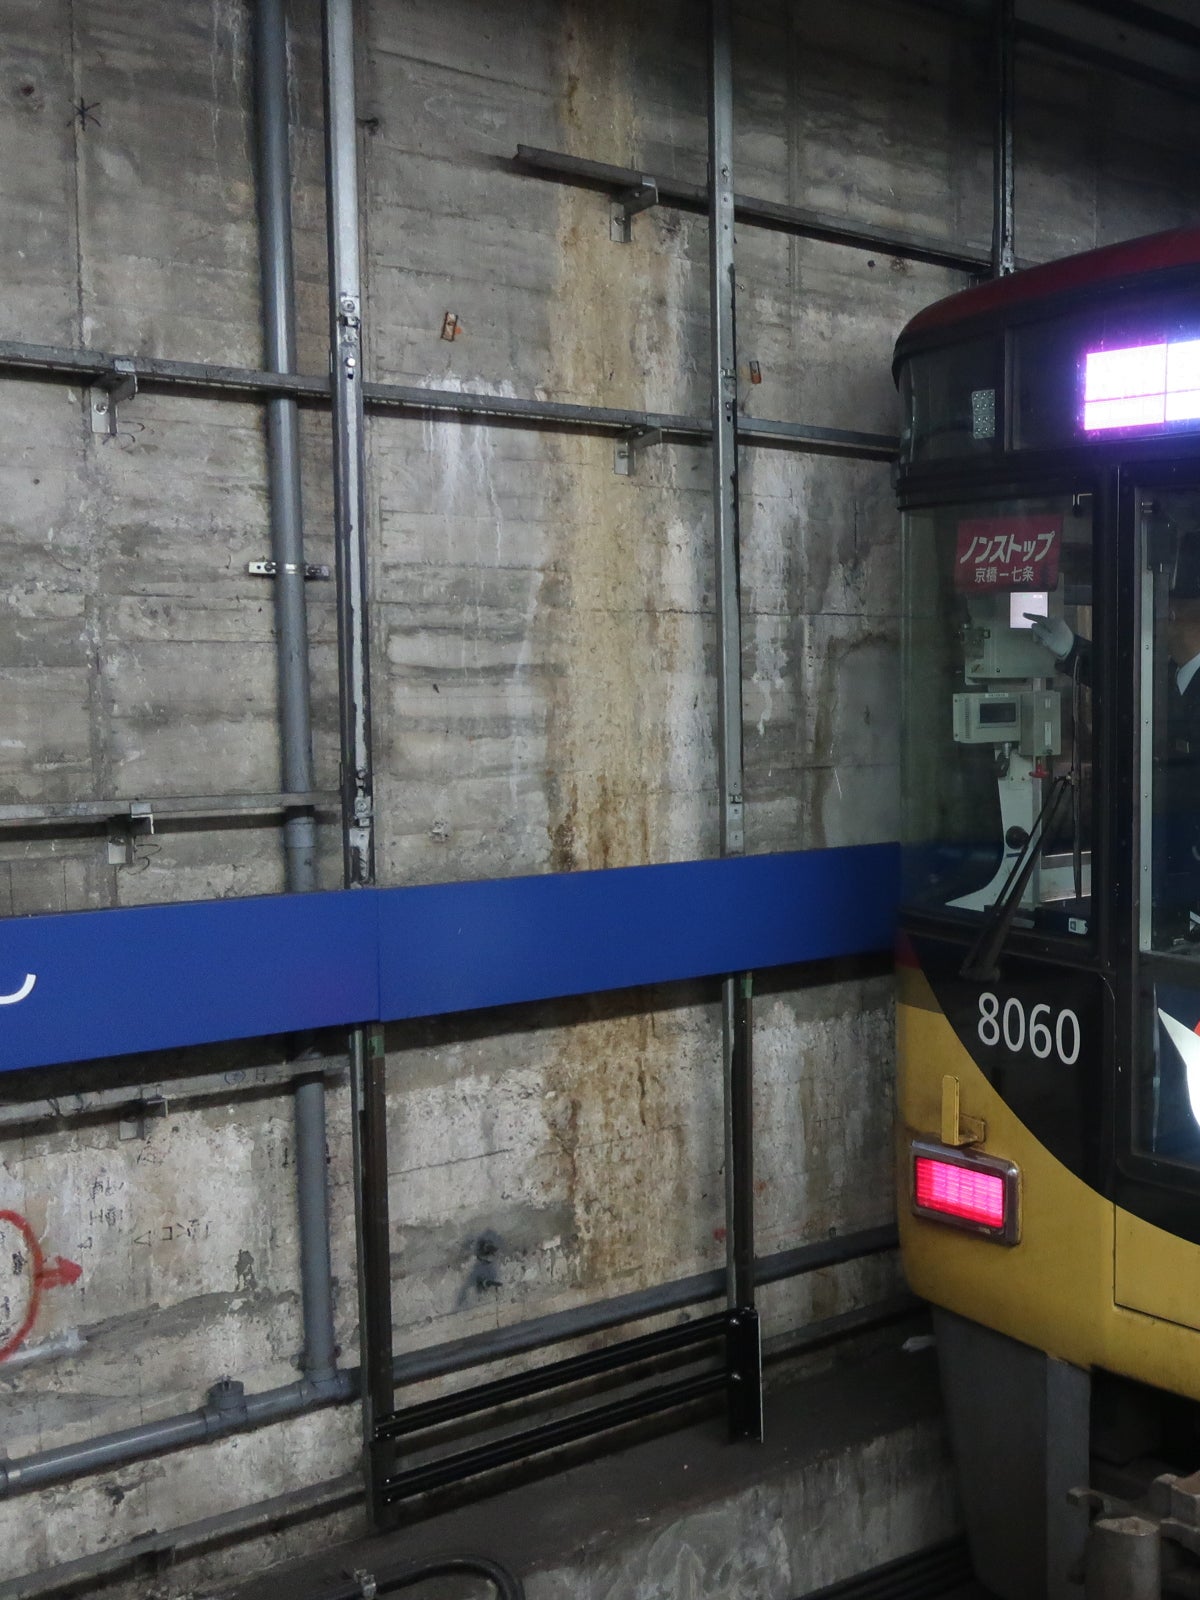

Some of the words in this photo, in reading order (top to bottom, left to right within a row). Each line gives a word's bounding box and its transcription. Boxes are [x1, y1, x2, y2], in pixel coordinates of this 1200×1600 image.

[960, 530, 1056, 564] ノンストップ
[977, 991, 1081, 1066] 8060
